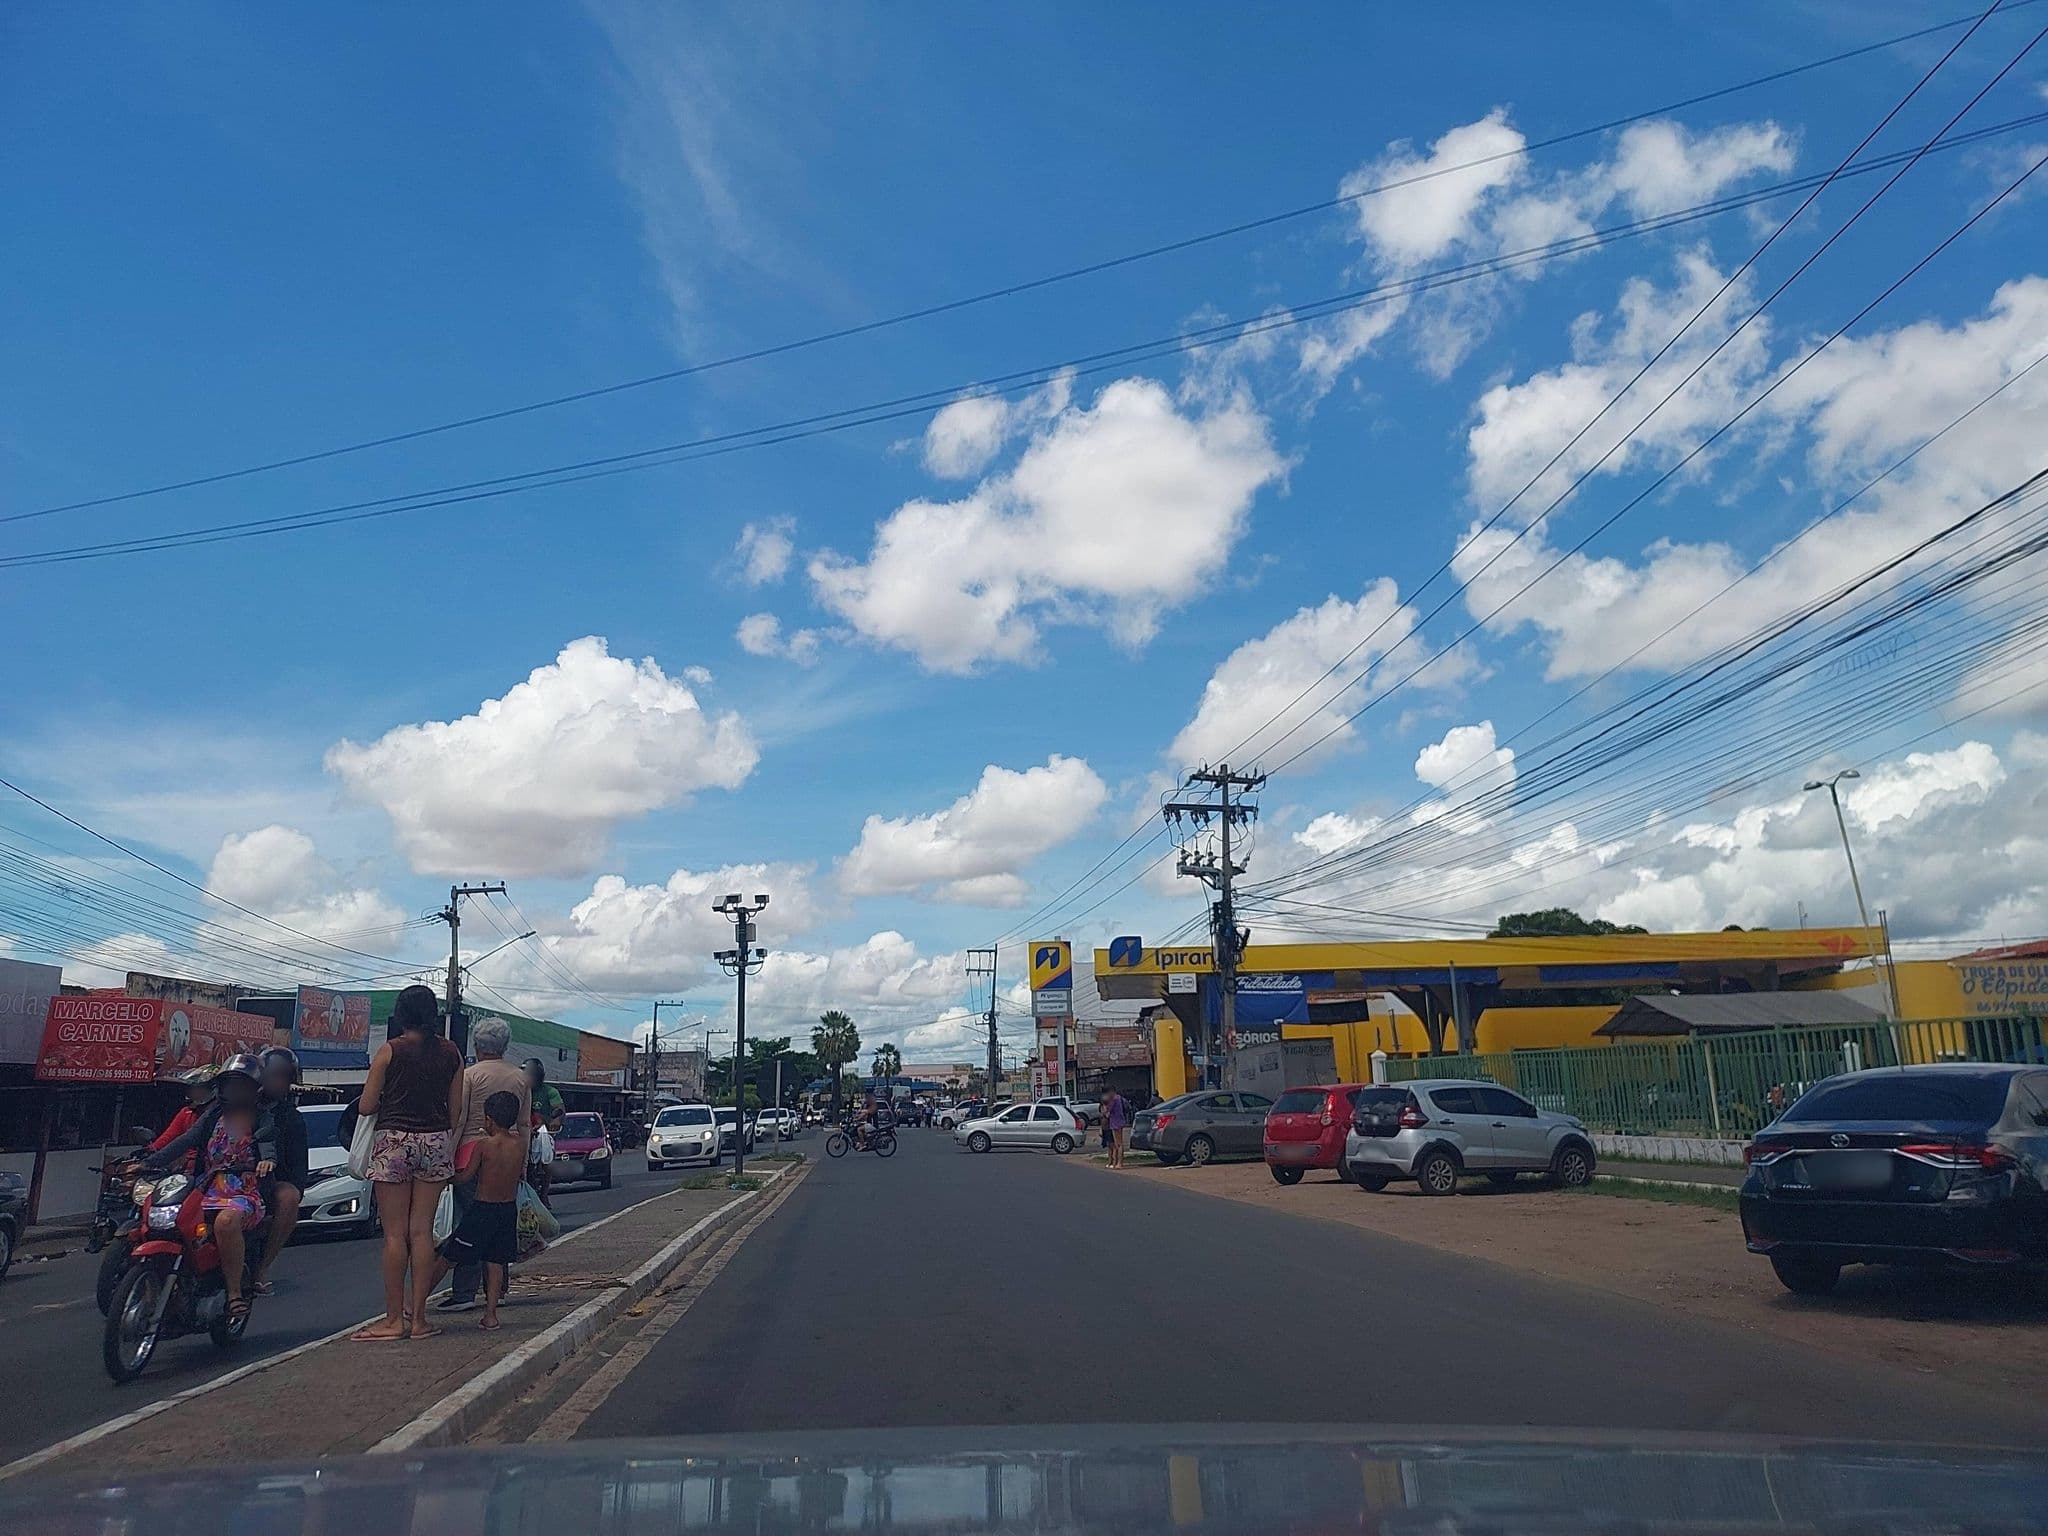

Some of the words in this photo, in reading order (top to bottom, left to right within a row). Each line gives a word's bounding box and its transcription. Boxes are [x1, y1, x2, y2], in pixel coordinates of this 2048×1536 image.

[53, 1001, 154, 1022] MARCELO
[192, 1009, 239, 1036] MARCELO
[59, 1023, 144, 1043] CARNES
[114, 1069, 149, 1079] 99503-1272
